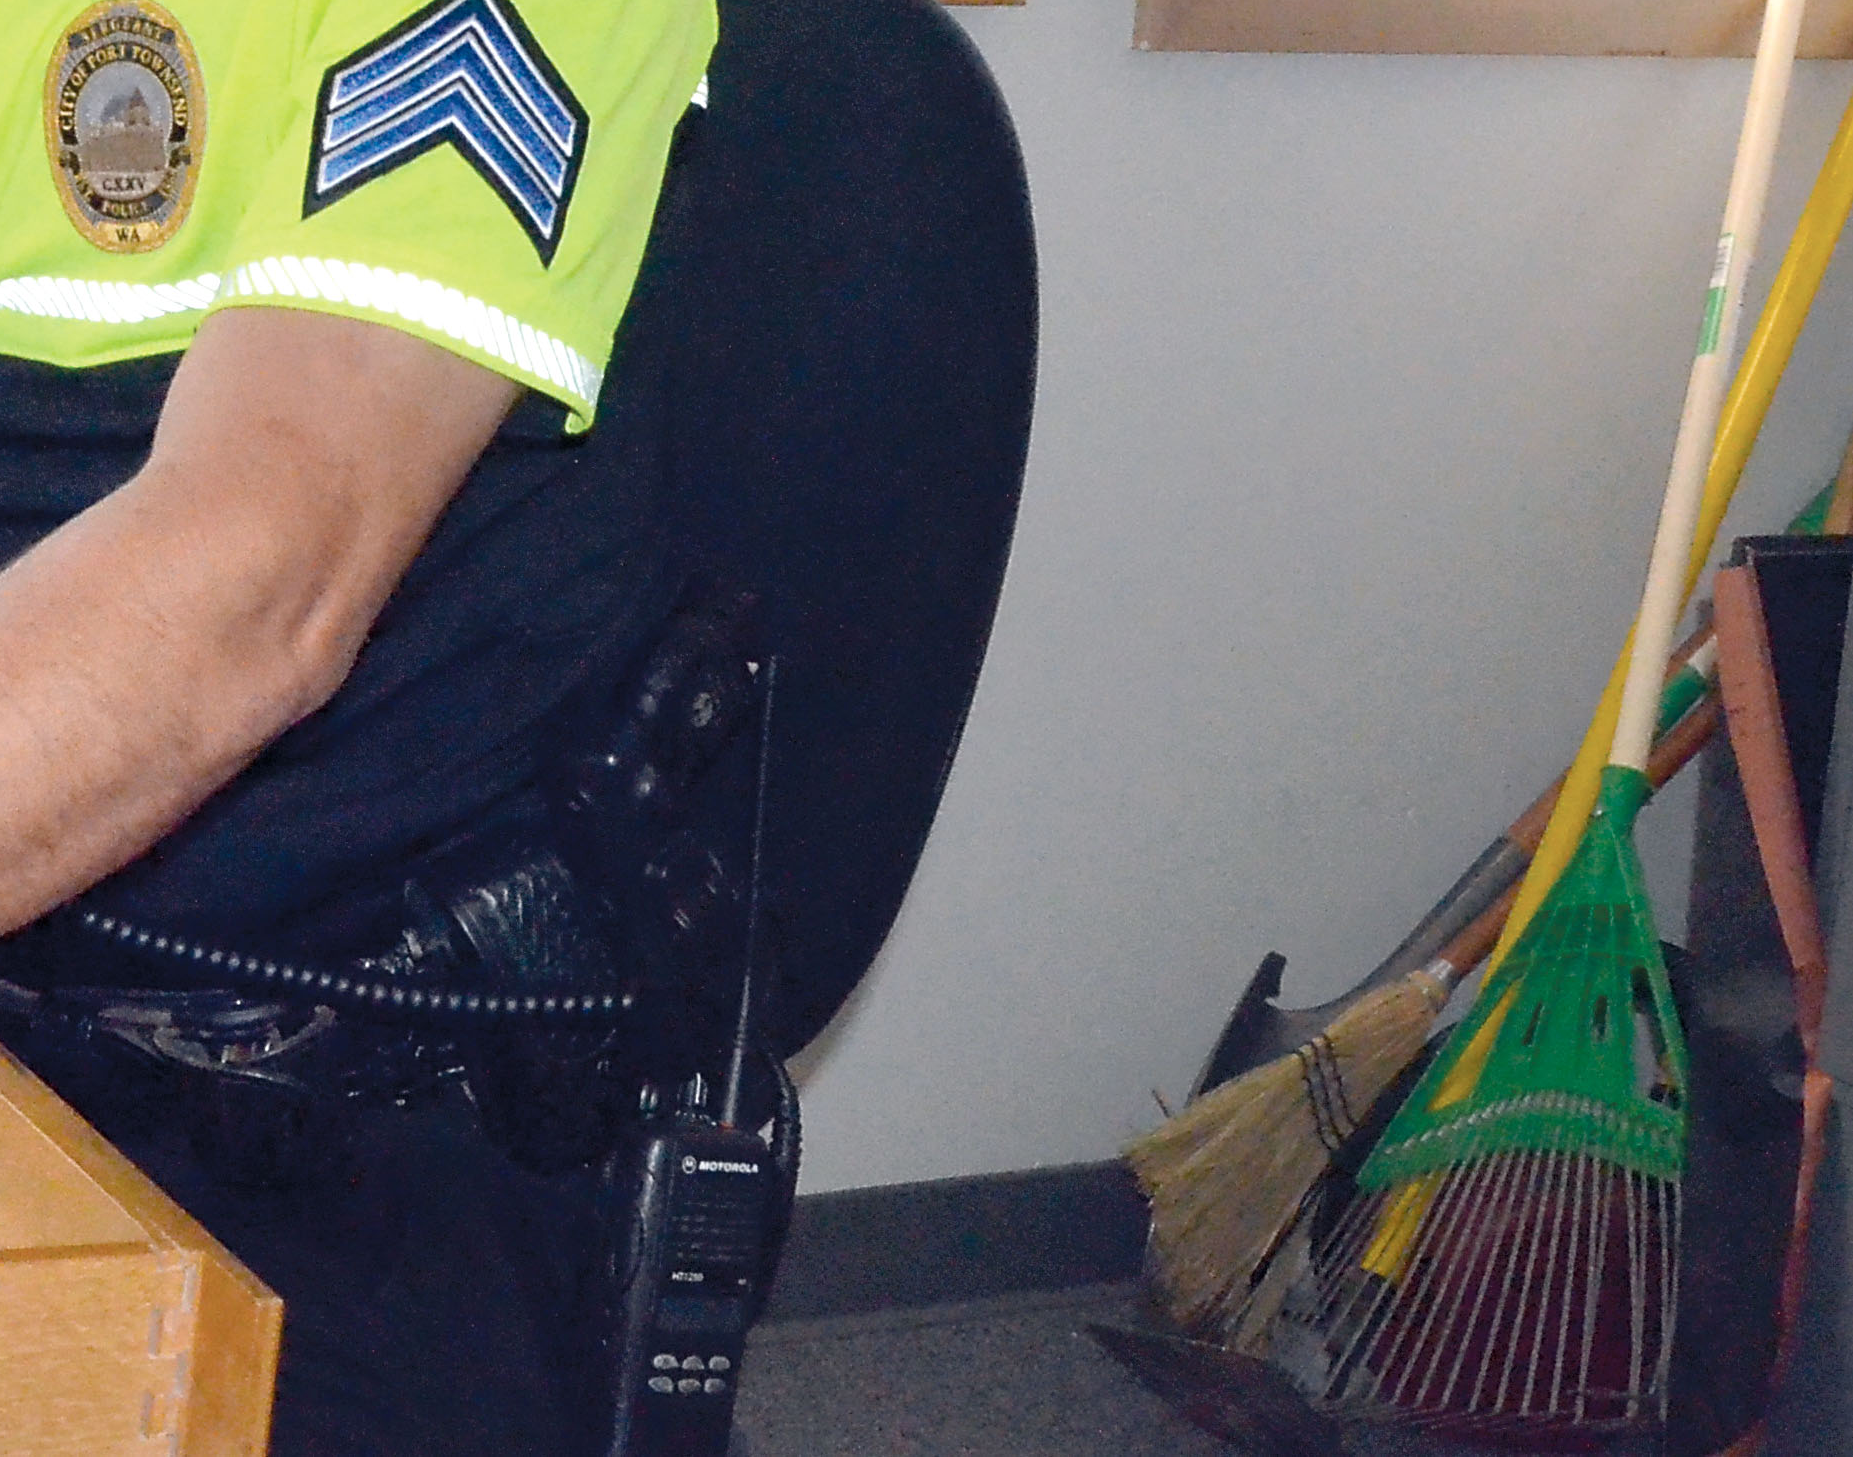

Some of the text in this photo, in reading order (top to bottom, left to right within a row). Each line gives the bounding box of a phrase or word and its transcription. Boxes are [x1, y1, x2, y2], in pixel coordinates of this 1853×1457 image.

[86, 44, 126, 70] PORT
[131, 44, 188, 126] TOWNSEND
[115, 228, 142, 243] WA
[698, 1160, 760, 1174] MOTOROLA
